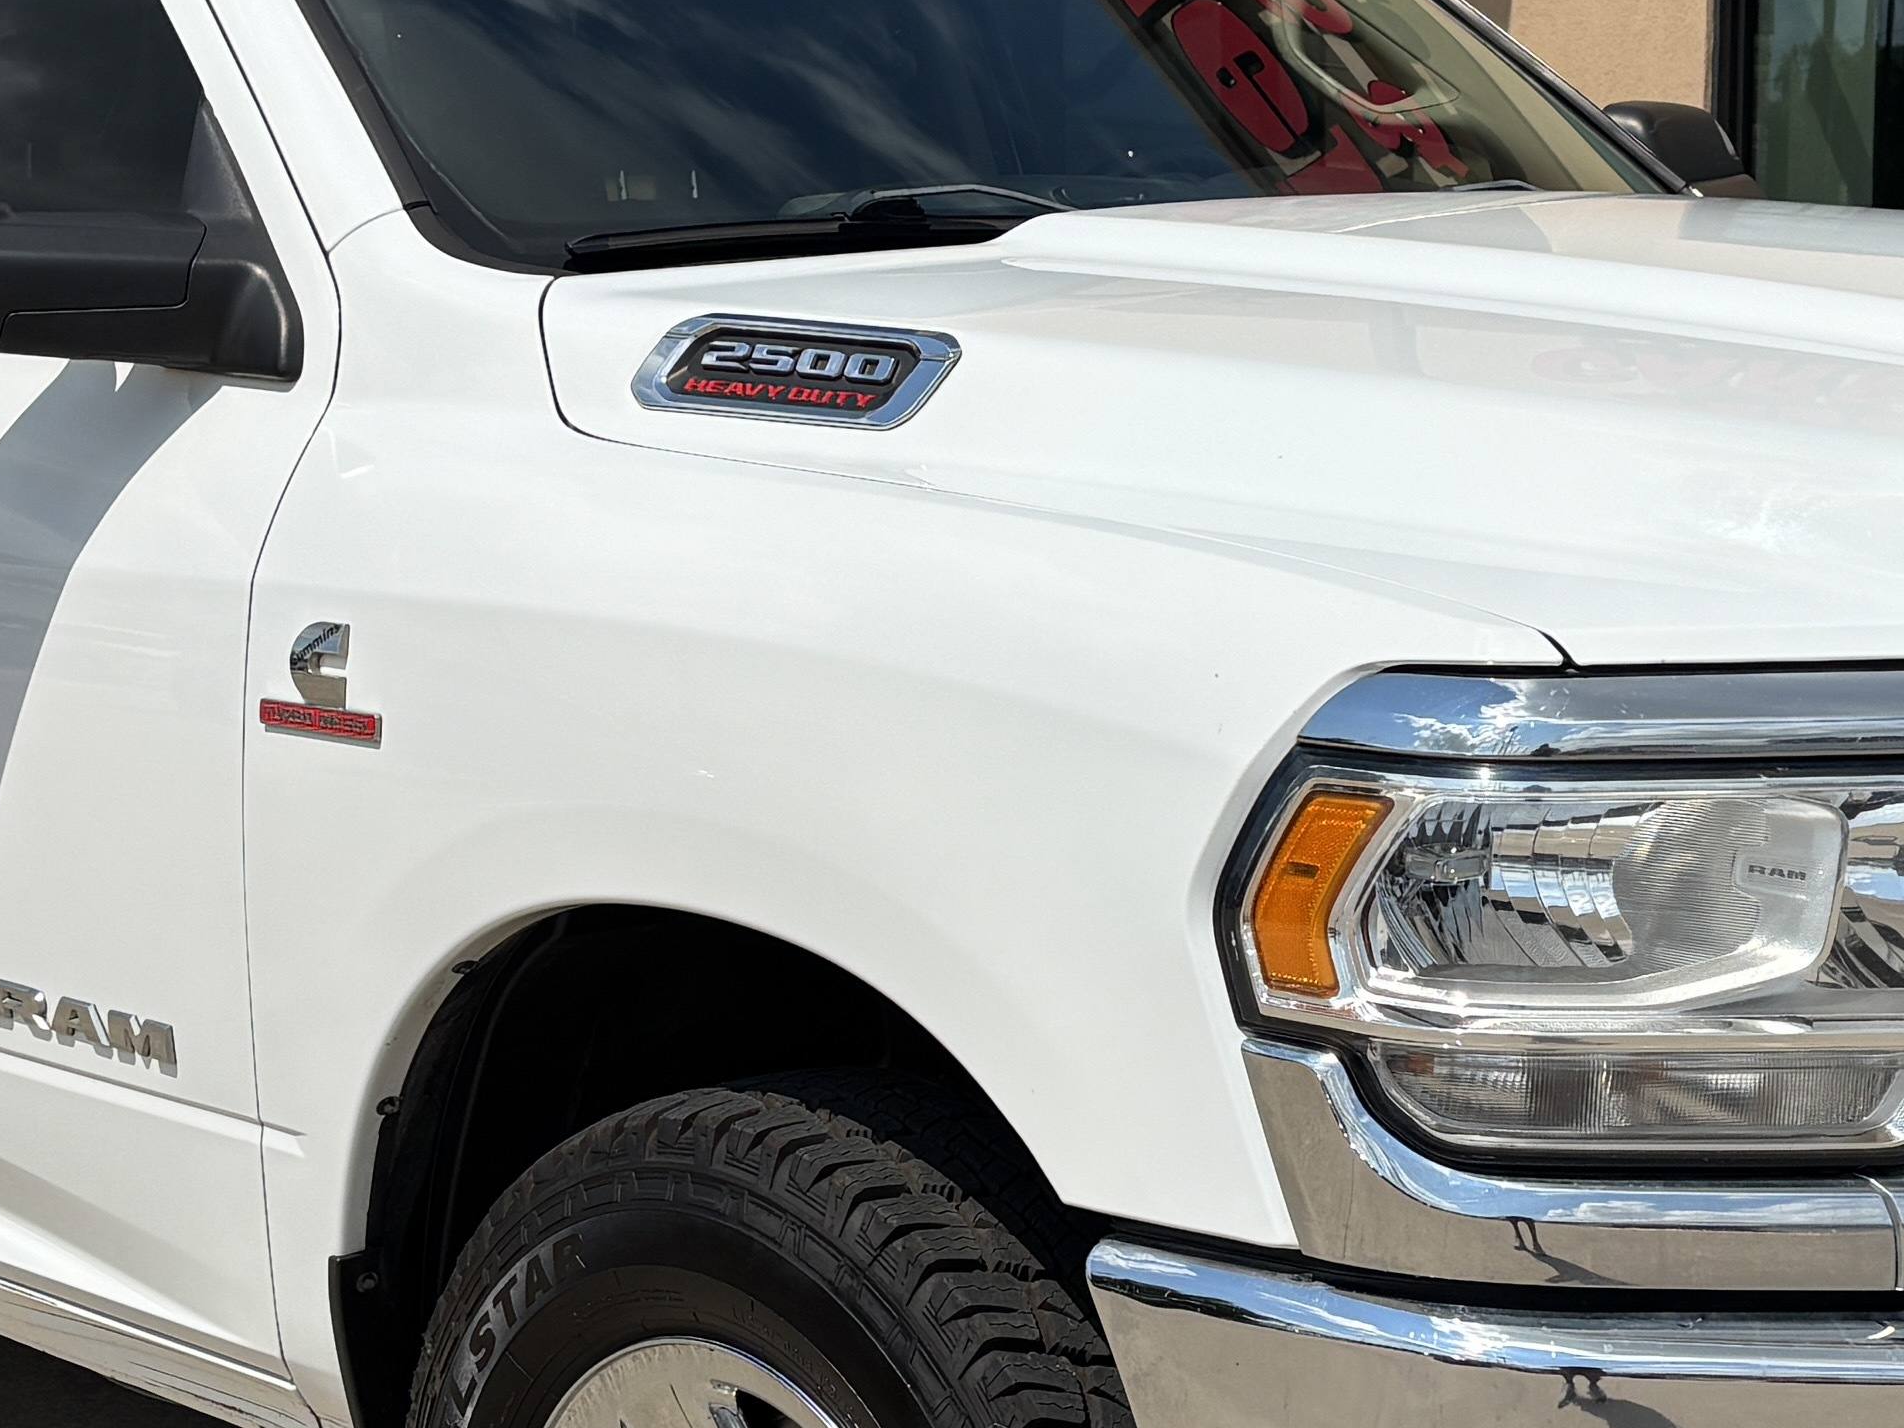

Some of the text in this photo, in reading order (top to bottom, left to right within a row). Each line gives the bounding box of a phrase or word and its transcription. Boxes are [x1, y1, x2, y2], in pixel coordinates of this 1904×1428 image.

[700, 340, 897, 384] 2500
[683, 378, 877, 408] HEAVY DUTY
[1747, 863, 1807, 883] RAM
